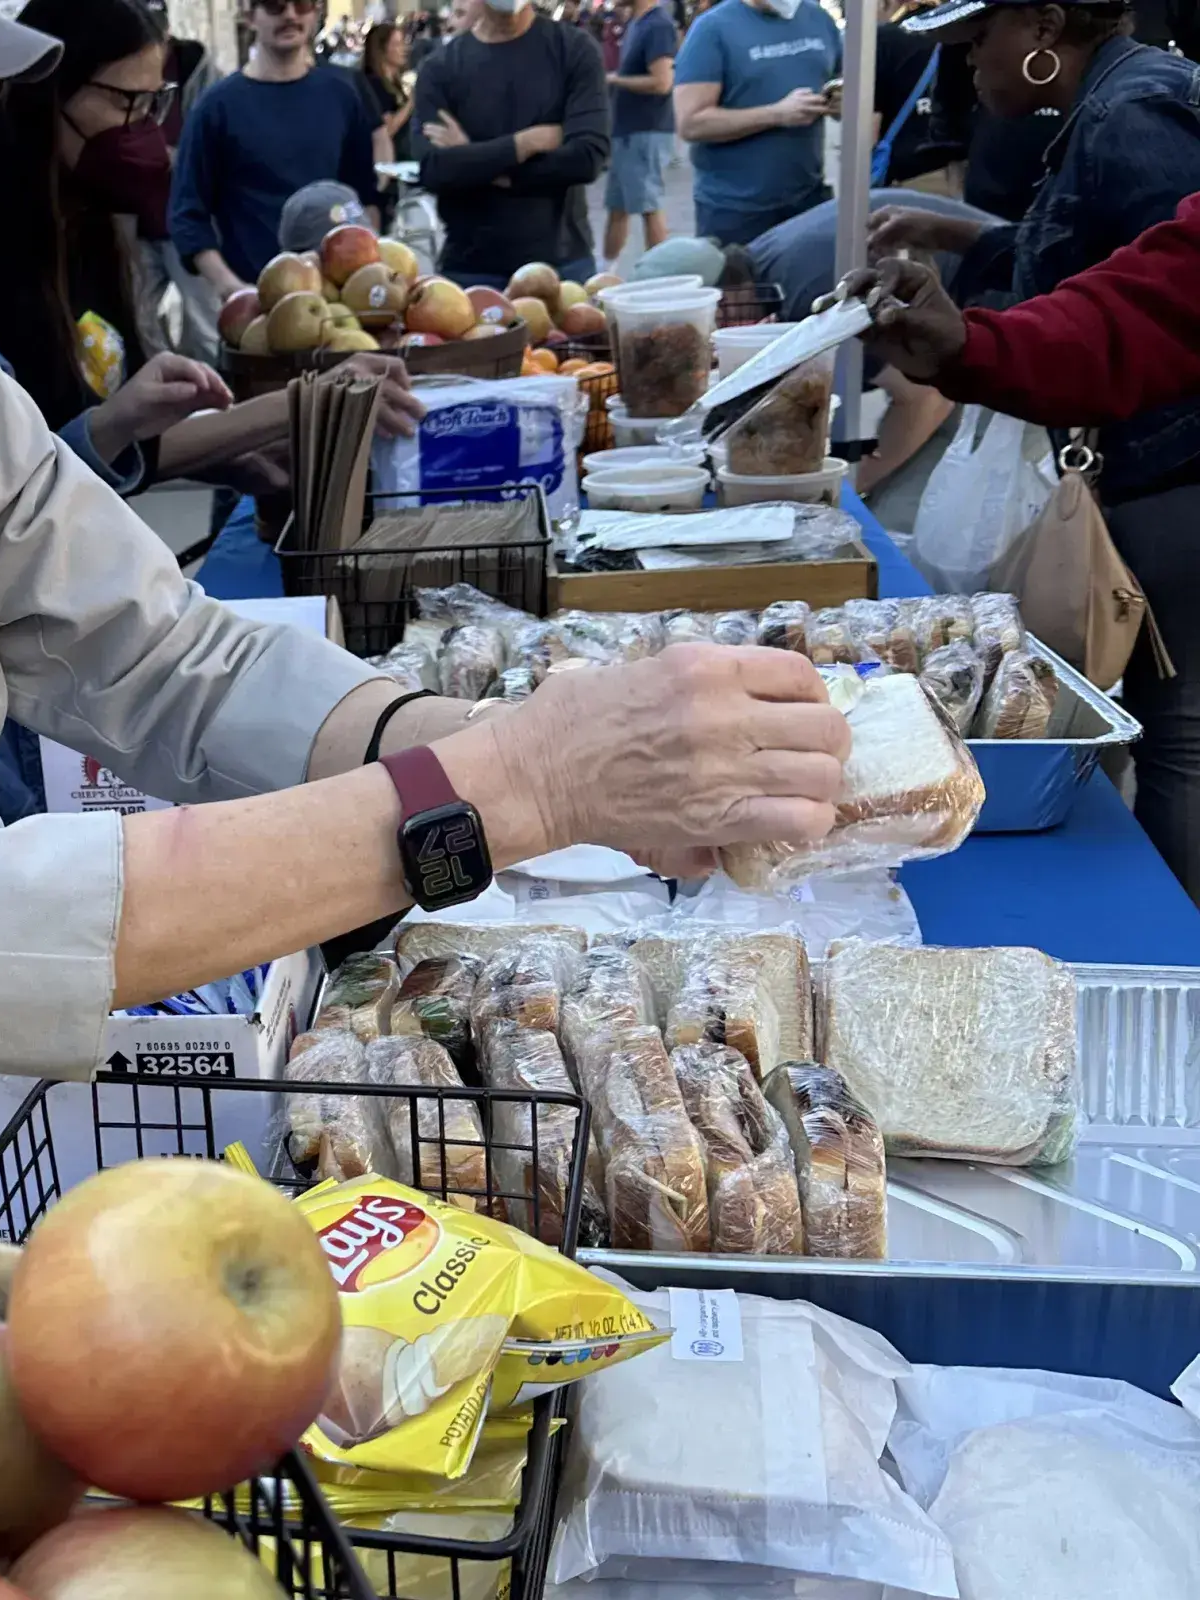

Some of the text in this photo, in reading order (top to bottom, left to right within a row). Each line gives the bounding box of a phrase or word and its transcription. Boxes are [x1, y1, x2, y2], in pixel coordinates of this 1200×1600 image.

[71, 790, 105, 799] CHEF'S
[224, 1041, 231, 1050] 0
[142, 1055, 229, 1076] 32564
[412, 1236, 492, 1315] Classic
[602, 1315, 620, 1335] OZ.
[439, 1396, 480, 1448] POTATO
